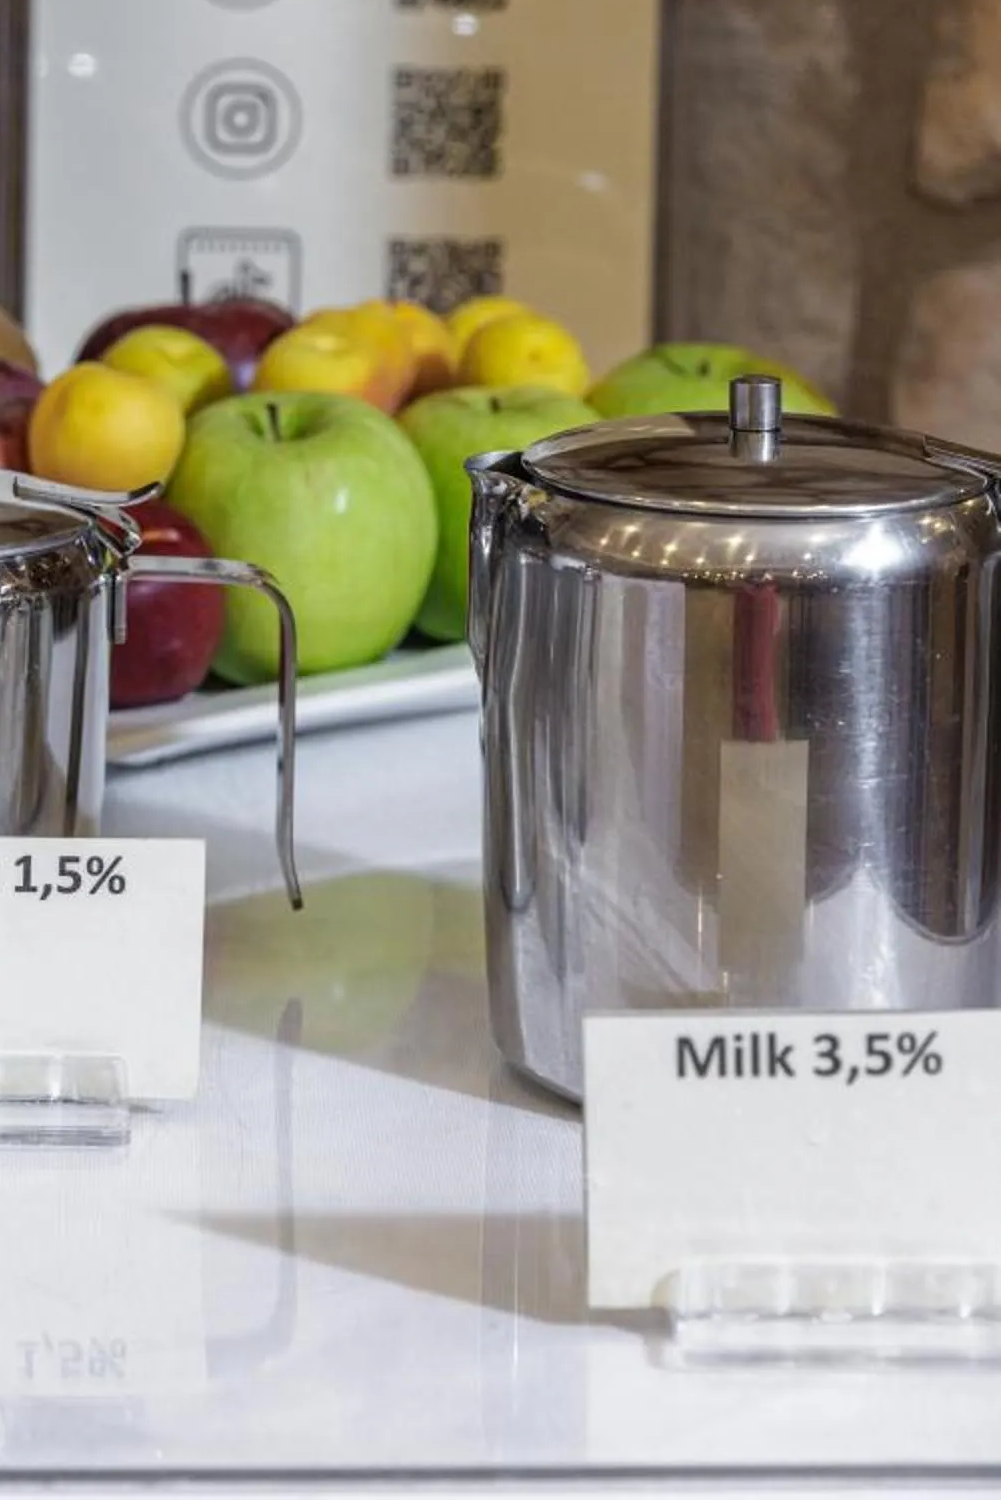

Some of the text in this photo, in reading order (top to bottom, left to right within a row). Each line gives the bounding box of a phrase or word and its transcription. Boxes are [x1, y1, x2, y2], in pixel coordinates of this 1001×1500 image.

[12, 854, 127, 903] 1,5%
[675, 1031, 943, 1085] Milk 3,5%
